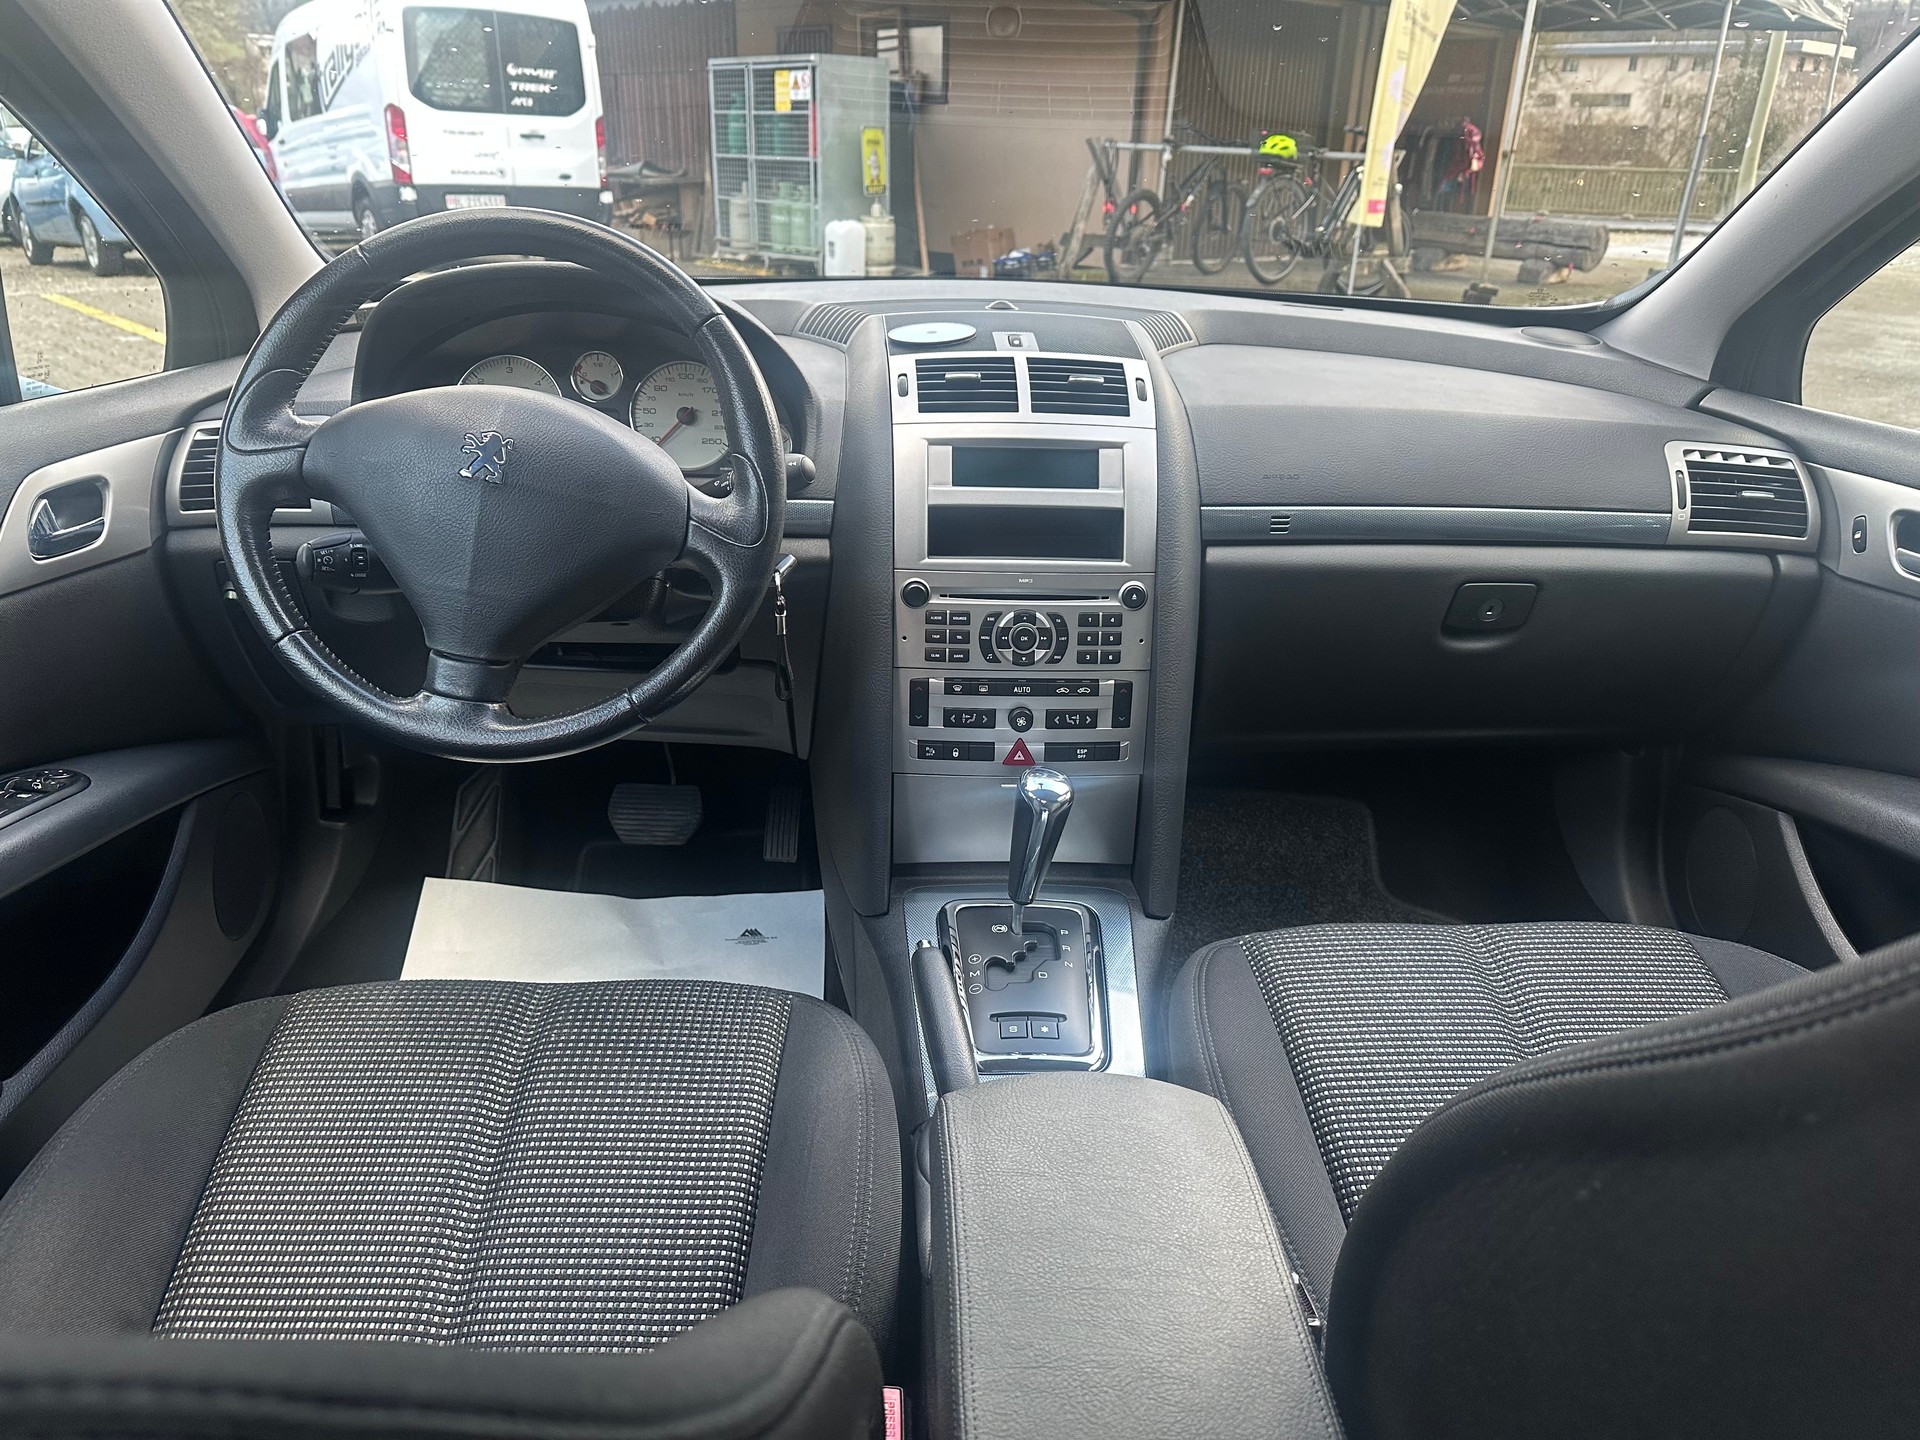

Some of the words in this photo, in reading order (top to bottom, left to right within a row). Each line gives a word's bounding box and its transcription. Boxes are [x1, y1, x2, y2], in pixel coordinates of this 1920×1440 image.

[505, 366, 513, 374] 3
[534, 379, 542, 387] 4
[642, 407, 657, 415] 50
[701, 437, 723, 445] 250
[969, 970, 980, 978] M
[1038, 971, 1048, 979] D
